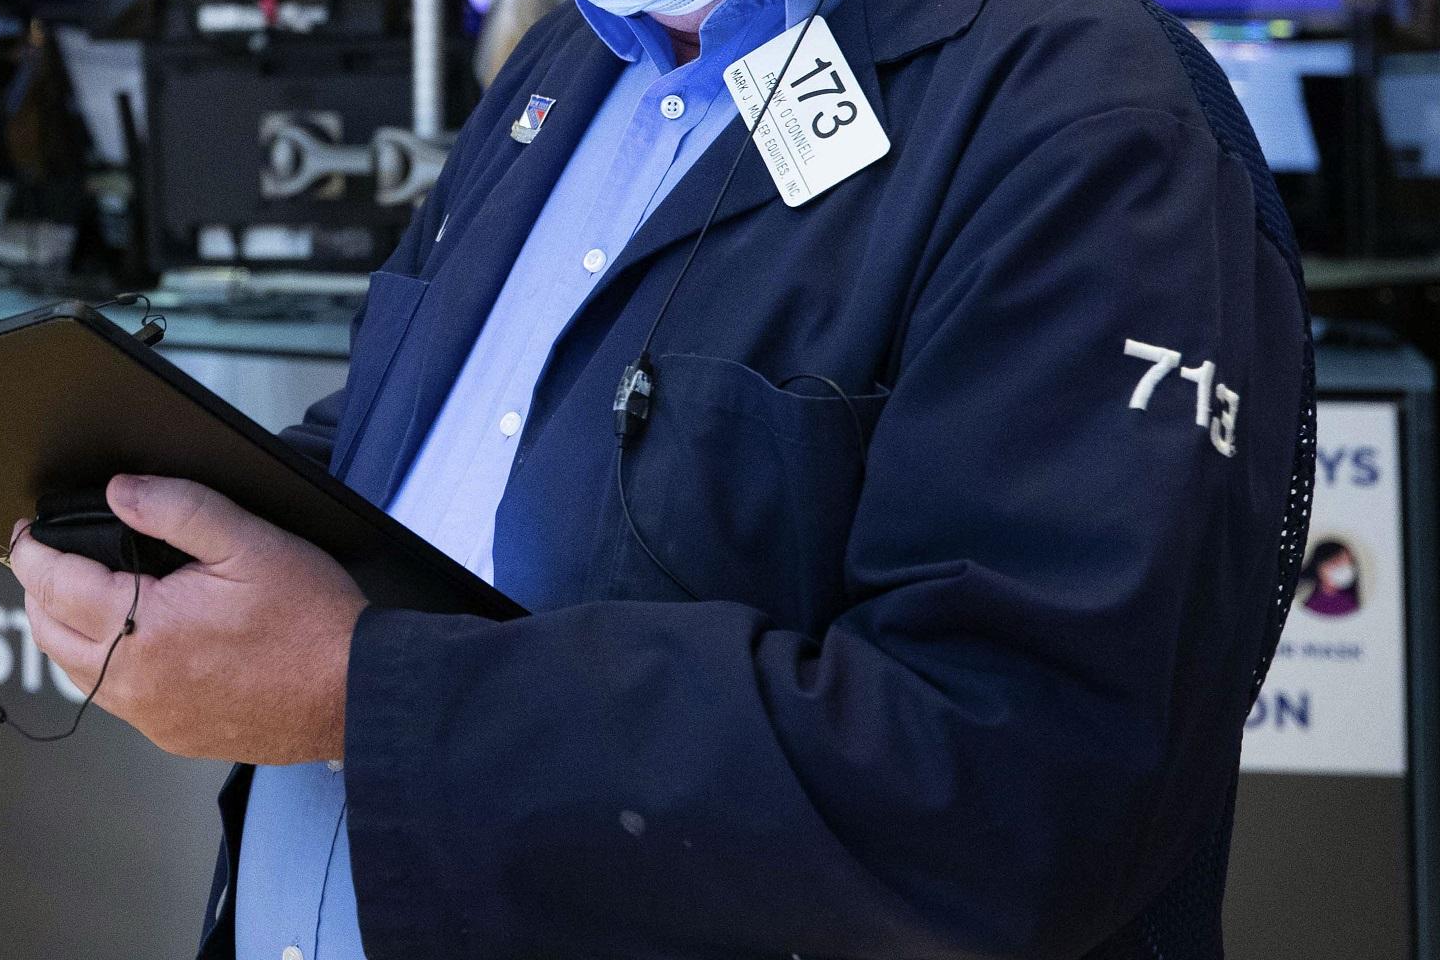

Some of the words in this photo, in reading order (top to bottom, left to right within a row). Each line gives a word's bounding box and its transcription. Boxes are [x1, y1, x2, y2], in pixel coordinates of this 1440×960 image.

[732, 68, 749, 93] MARK
[748, 104, 771, 138] MUER
[761, 72, 788, 107] FRNK
[780, 108, 815, 166] O'CONNELL
[790, 57, 858, 139] 173
[1123, 338, 1239, 458] 713
